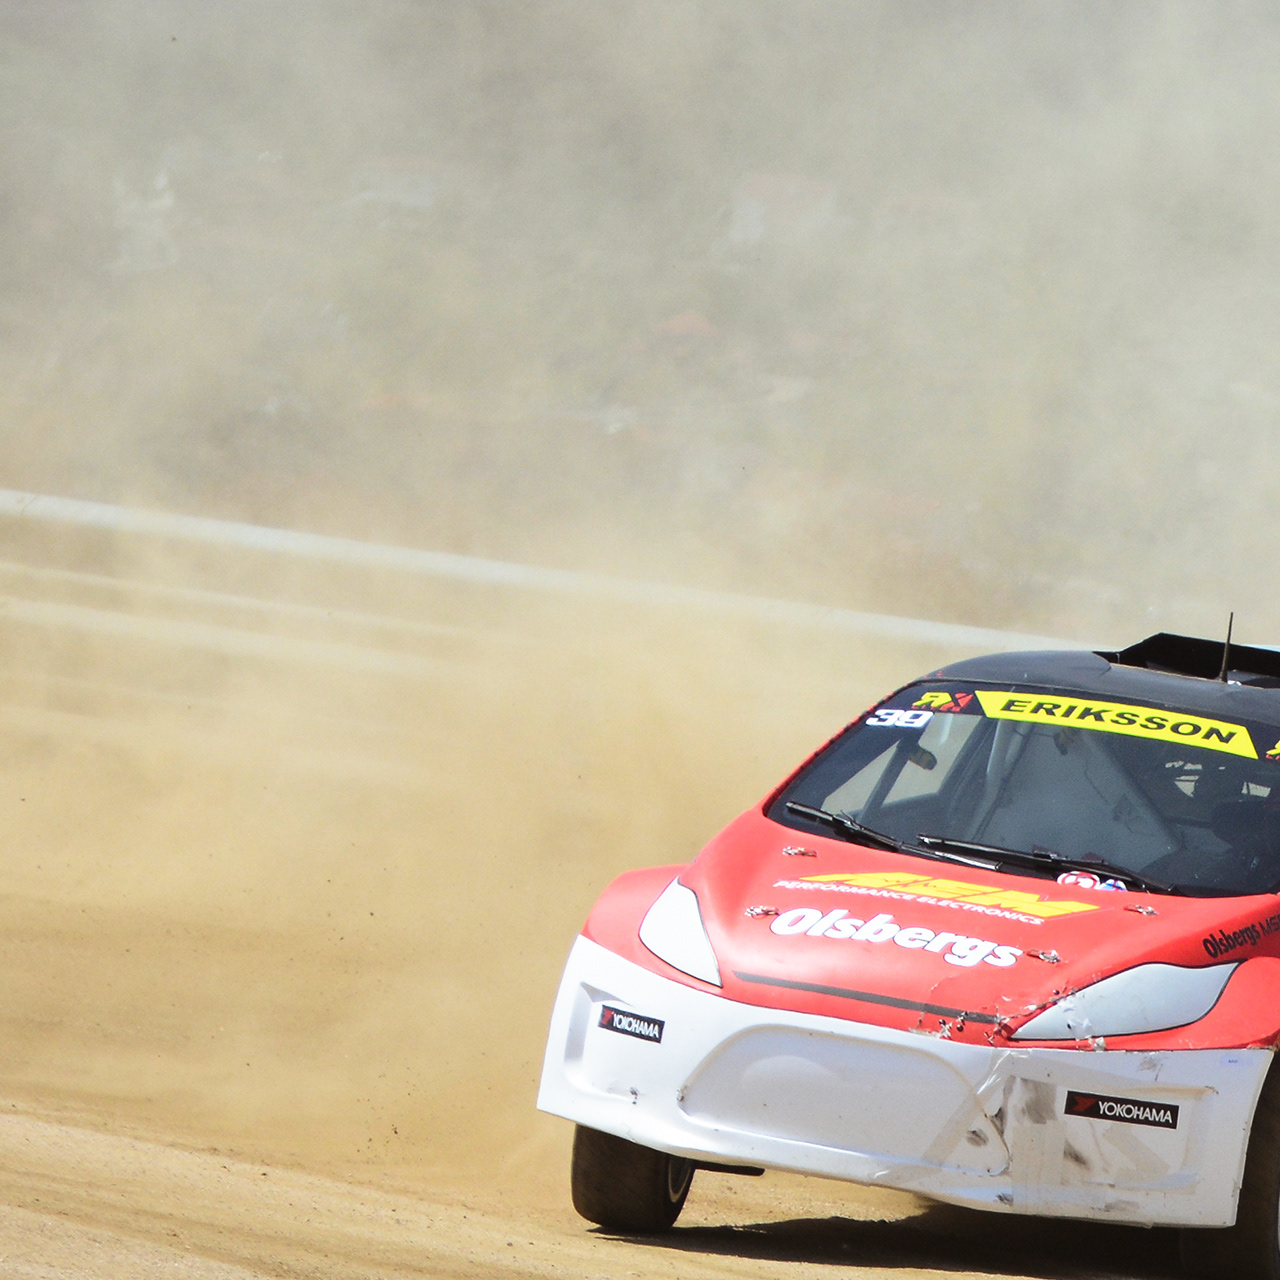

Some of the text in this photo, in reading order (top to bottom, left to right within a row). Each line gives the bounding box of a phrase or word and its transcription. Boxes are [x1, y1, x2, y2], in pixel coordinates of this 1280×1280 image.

[866, 709, 934, 728] 39
[1000, 698, 1238, 745] ERIKSSON
[772, 880, 1046, 925] PERFORMANCE ELECTRONICS
[799, 871, 1101, 918] AEM
[769, 907, 1025, 968] Olsbergs
[1202, 923, 1261, 959] Olsbergs
[613, 1013, 660, 1039] YOKOHAMA
[1098, 1100, 1173, 1124] YOKOHAMA
